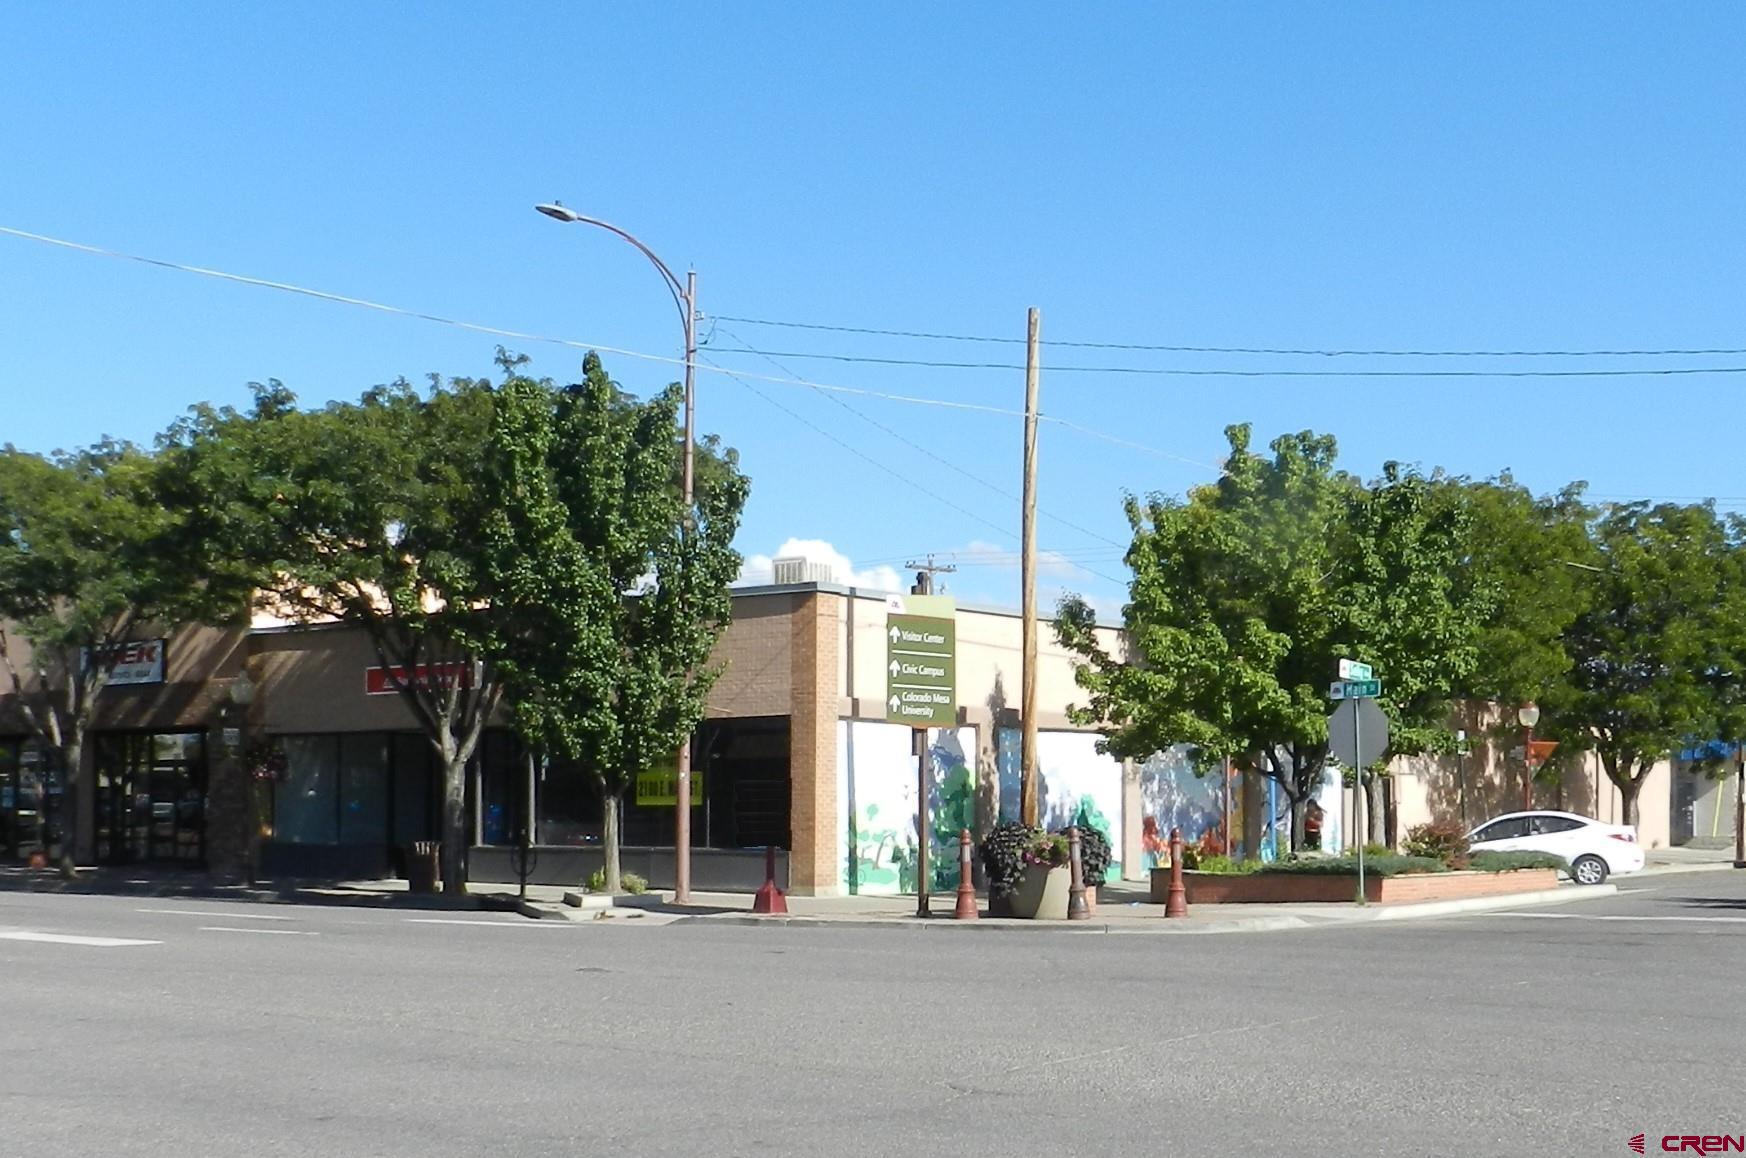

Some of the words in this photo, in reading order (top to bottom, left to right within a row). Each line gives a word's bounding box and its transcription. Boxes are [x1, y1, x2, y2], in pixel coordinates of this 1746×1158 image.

[902, 630, 922, 642] Visitor
[923, 632, 945, 644] Center
[902, 664, 918, 675] Civic
[919, 665, 945, 678] Campus
[1346, 684, 1367, 696] Main
[902, 692, 932, 703] Colorado
[932, 693, 950, 704] Mesa
[902, 705, 934, 719] University
